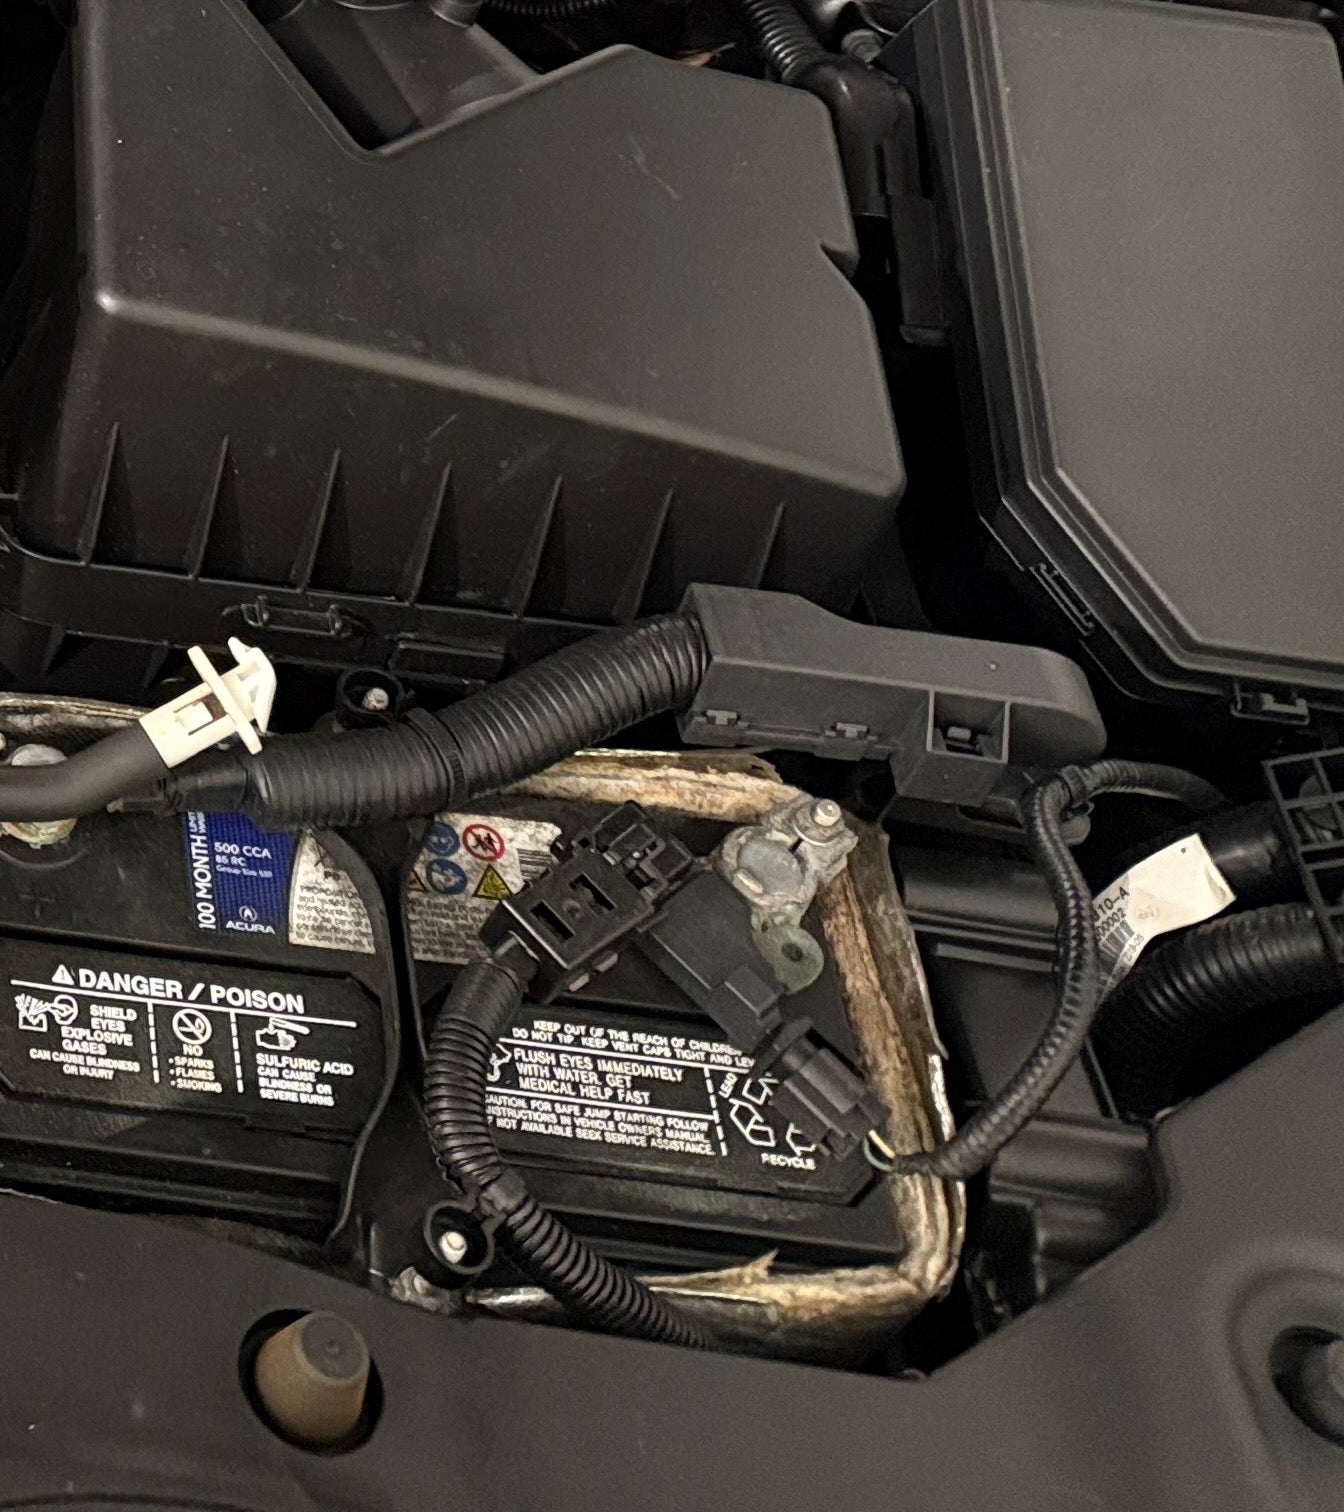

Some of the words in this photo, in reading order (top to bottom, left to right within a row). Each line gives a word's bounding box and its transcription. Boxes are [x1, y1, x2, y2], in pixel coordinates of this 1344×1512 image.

[214, 841, 240, 856] 500
[242, 845, 272, 860] CCA
[189, 834, 213, 899] MONTH
[230, 856, 248, 867] RC
[197, 902, 217, 930] 100
[225, 920, 276, 935] ACURA
[78, 968, 184, 1000] DANGER
[209, 984, 305, 1015] POISON
[89, 1004, 138, 1022] SHIELD
[91, 1017, 126, 1032] EYES
[61, 1026, 134, 1047] EXPLOSIVE
[533, 1020, 561, 1032] KEEP
[563, 1023, 587, 1037] OUT
[589, 1025, 604, 1038] OF
[607, 1028, 629, 1041] THE
[631, 1032, 668, 1047] REACH
[670, 1037, 686, 1049] OF
[62, 1039, 107, 1055] GASES
[183, 1044, 204, 1057] NO
[512, 1027, 528, 1039] DO
[531, 1029, 553, 1043] NOT
[581, 1036, 609, 1050] KEEP
[611, 1039, 639, 1054] VENT
[642, 1043, 672, 1058] CAPS
[675, 1048, 707, 1062] TIGHT
[709, 1052, 733, 1066] AND
[29, 1048, 51, 1061] CAN
[52, 1051, 85, 1065] CAUSE
[86, 1054, 140, 1072] BLINDNESS
[175, 1056, 214, 1070] SPARKS
[255, 1053, 321, 1073] SULFURIC
[322, 1061, 354, 1076] ACID
[513, 1048, 556, 1066] FLUSH
[560, 1054, 593, 1071] EYES
[597, 1059, 685, 1083] IMMEDIATELY
[63, 1064, 79, 1075] OR
[79, 1066, 115, 1080] INJURY
[175, 1068, 215, 1081] FLAMES
[257, 1066, 279, 1078] CAN
[282, 1070, 317, 1083] CAUSE
[516, 1062, 551, 1079] WITH
[605, 1074, 632, 1089] GET
[176, 1080, 223, 1094] SMOKING
[258, 1077, 313, 1093] BLINDNESS
[315, 1084, 333, 1095] OR
[518, 1076, 577, 1097] MEDICAL
[579, 1083, 613, 1101] HELP
[617, 1089, 651, 1106] FAST
[718, 1072, 739, 1099] LEAD
[260, 1088, 300, 1103] SEVERE
[300, 1094, 335, 1107] BURNS
[530, 1099, 553, 1112] FOR
[554, 1103, 581, 1117] SAFE
[583, 1107, 611, 1121] JUMP
[613, 1110, 665, 1127] STARTING
[666, 1117, 709, 1132] FOLLOW
[559, 1114, 572, 1126] IN
[573, 1117, 615, 1133] VEHICLE
[496, 1117, 518, 1130] NOT
[520, 1120, 574, 1138] AVAILABLE
[575, 1127, 603, 1141] SEEK
[604, 1132, 648, 1148] SERVICE
[760, 1152, 816, 1170] RECYCLE
